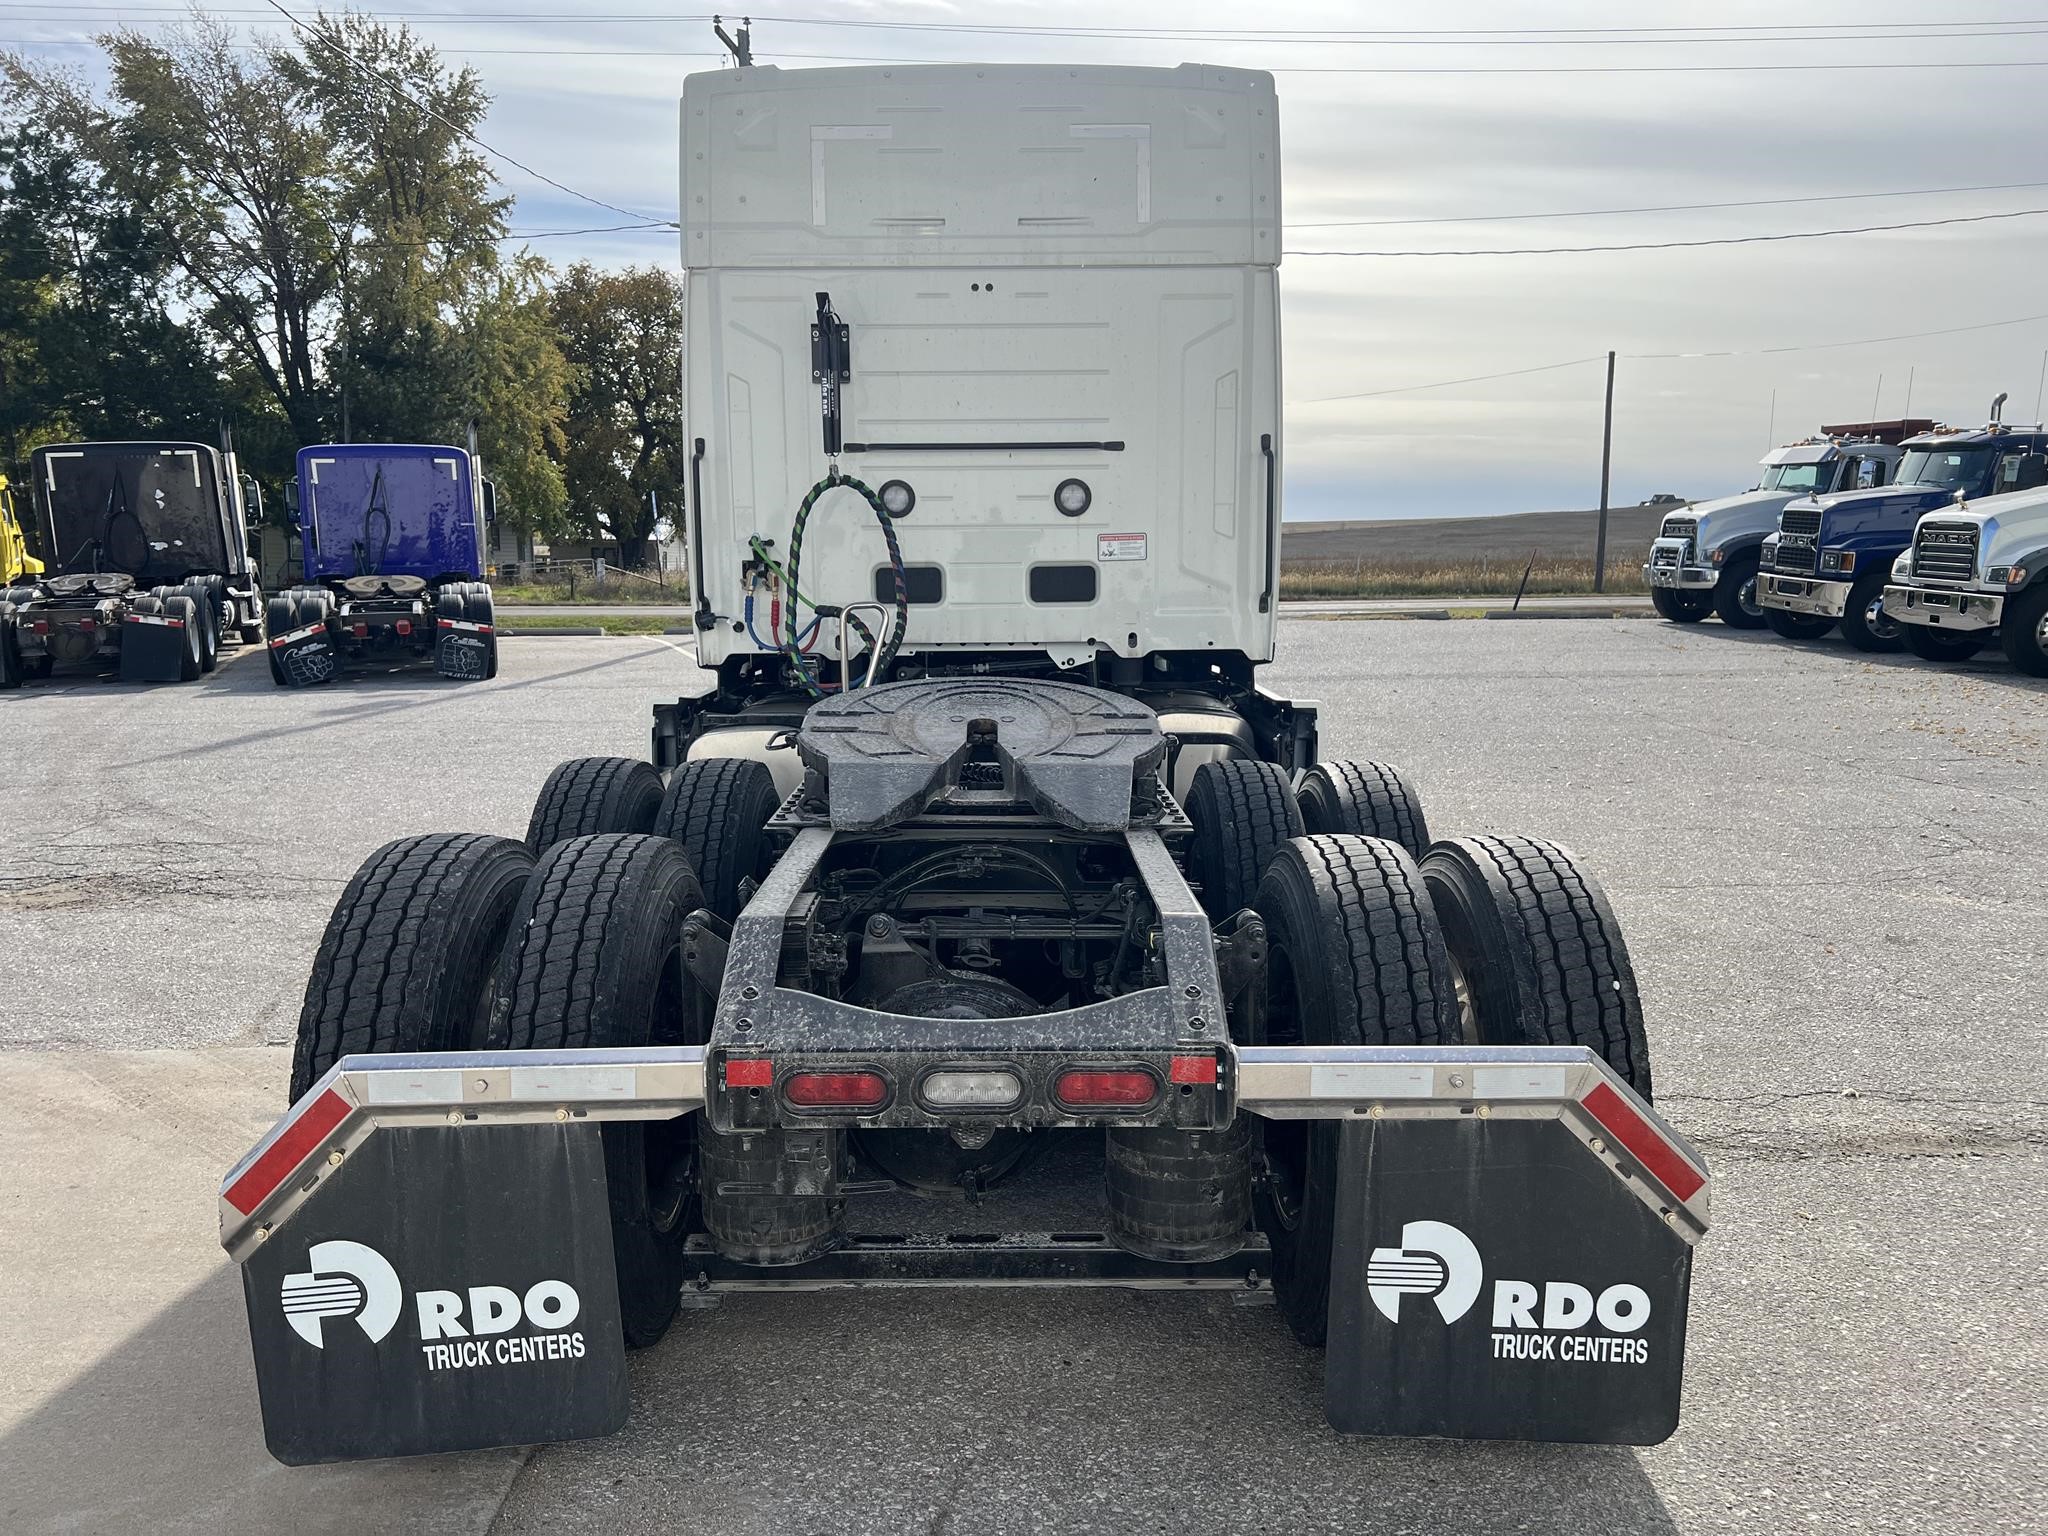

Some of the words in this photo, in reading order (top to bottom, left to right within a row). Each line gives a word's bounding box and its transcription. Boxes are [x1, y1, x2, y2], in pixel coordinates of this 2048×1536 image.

[1781, 535, 1811, 546] MACK
[1923, 534, 1971, 543] MACK
[415, 1280, 580, 1340] RDO
[1492, 1279, 1651, 1333] RDO
[422, 1340, 492, 1371] TRUCK
[495, 1332, 586, 1364] CENTERS
[1491, 1333, 1556, 1360] TRUCK
[1560, 1336, 1648, 1364] CENTERS
